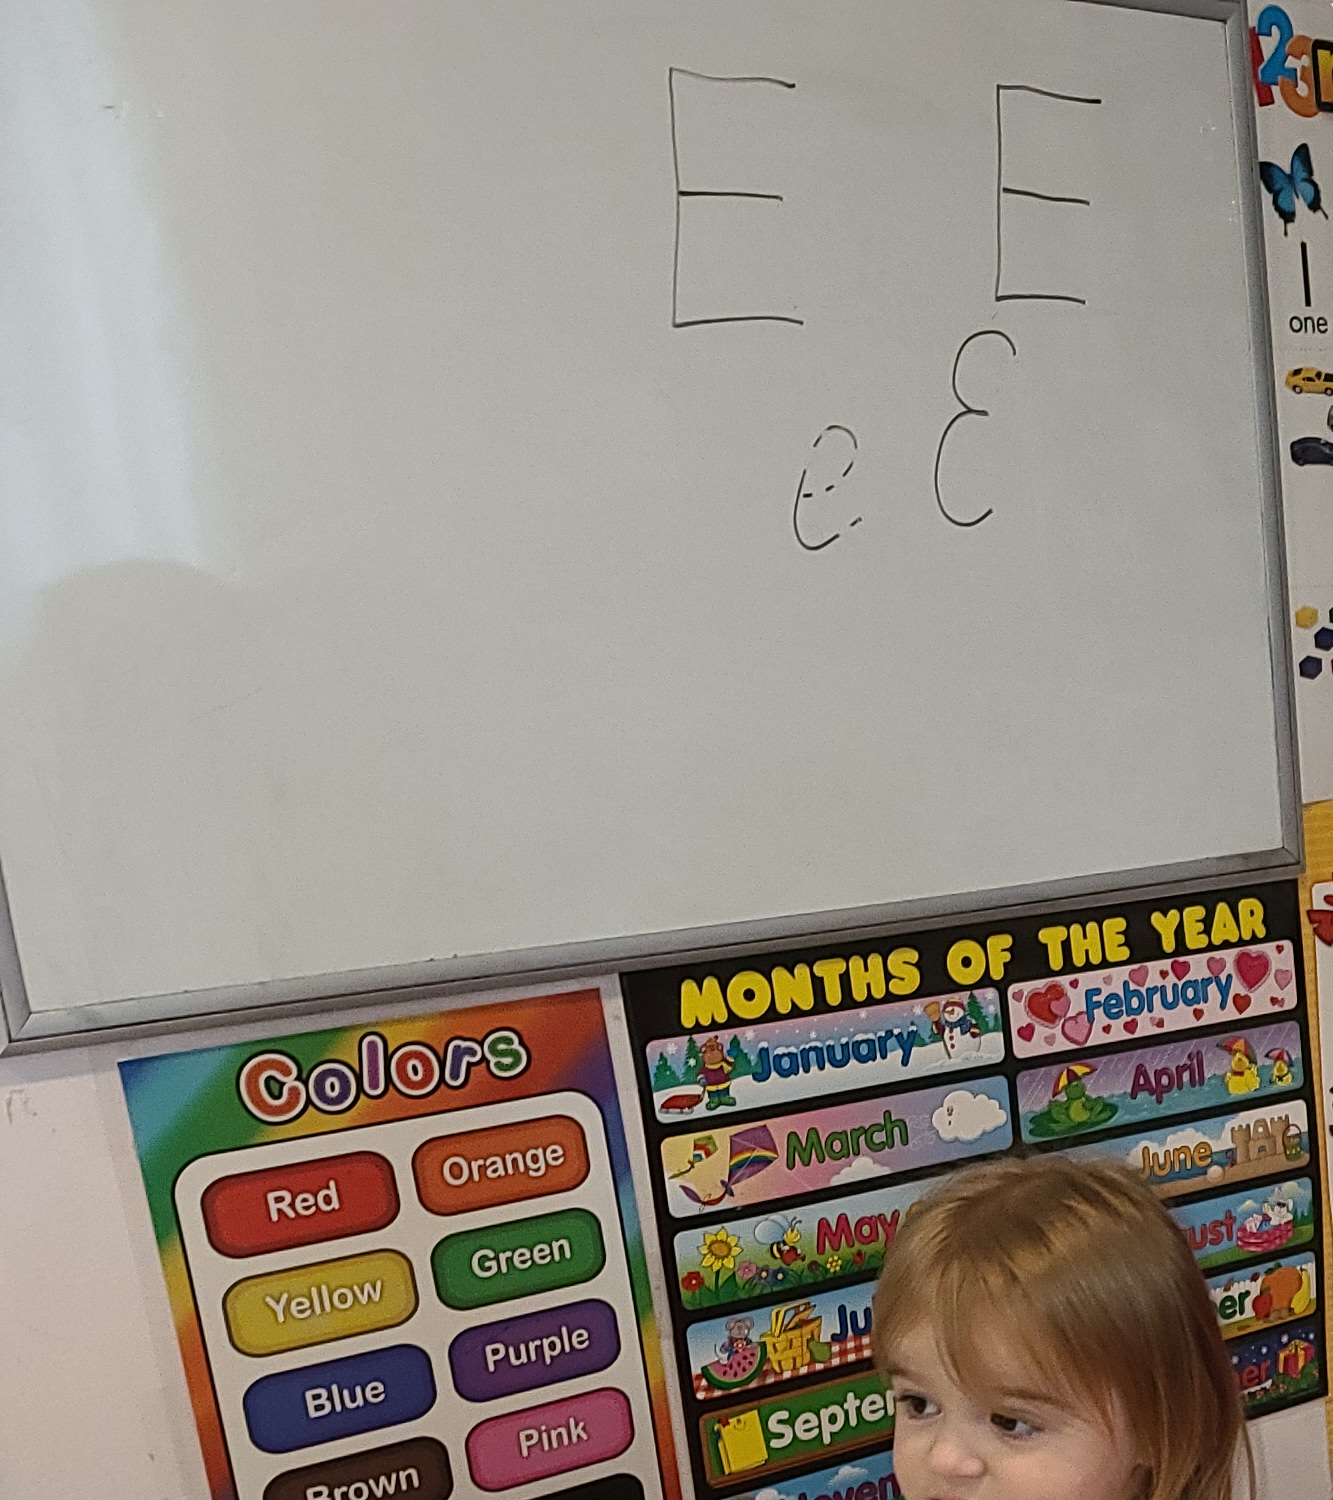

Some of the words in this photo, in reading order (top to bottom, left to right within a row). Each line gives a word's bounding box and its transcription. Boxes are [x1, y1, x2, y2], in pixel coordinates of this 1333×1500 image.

[670, 67, 803, 328] E
[995, 84, 1101, 302] E
[1300, 241, 1312, 307] 1
[1289, 314, 1329, 334] one
[680, 947, 921, 1029] MONTHS
[946, 933, 1013, 986] OF
[1038, 917, 1131, 971] THE
[1150, 897, 1267, 954] YEAR
[1084, 972, 1234, 1023] February
[239, 1026, 532, 1125] Colors
[751, 1025, 918, 1083] January
[1130, 1050, 1205, 1105] April
[442, 1141, 566, 1187] Orange
[785, 1109, 909, 1171] March
[1140, 1140, 1212, 1179] June
[266, 1179, 341, 1224] Red
[816, 1209, 900, 1255] May
[1186, 1209, 1237, 1250] ust
[471, 1233, 572, 1279] Green
[265, 1275, 384, 1324] Yellow
[831, 1304, 872, 1342] Ju
[485, 1325, 590, 1374] Purple
[303, 1376, 386, 1419] Blue
[767, 1389, 896, 1449] Septe
[519, 1416, 589, 1459] Pink
